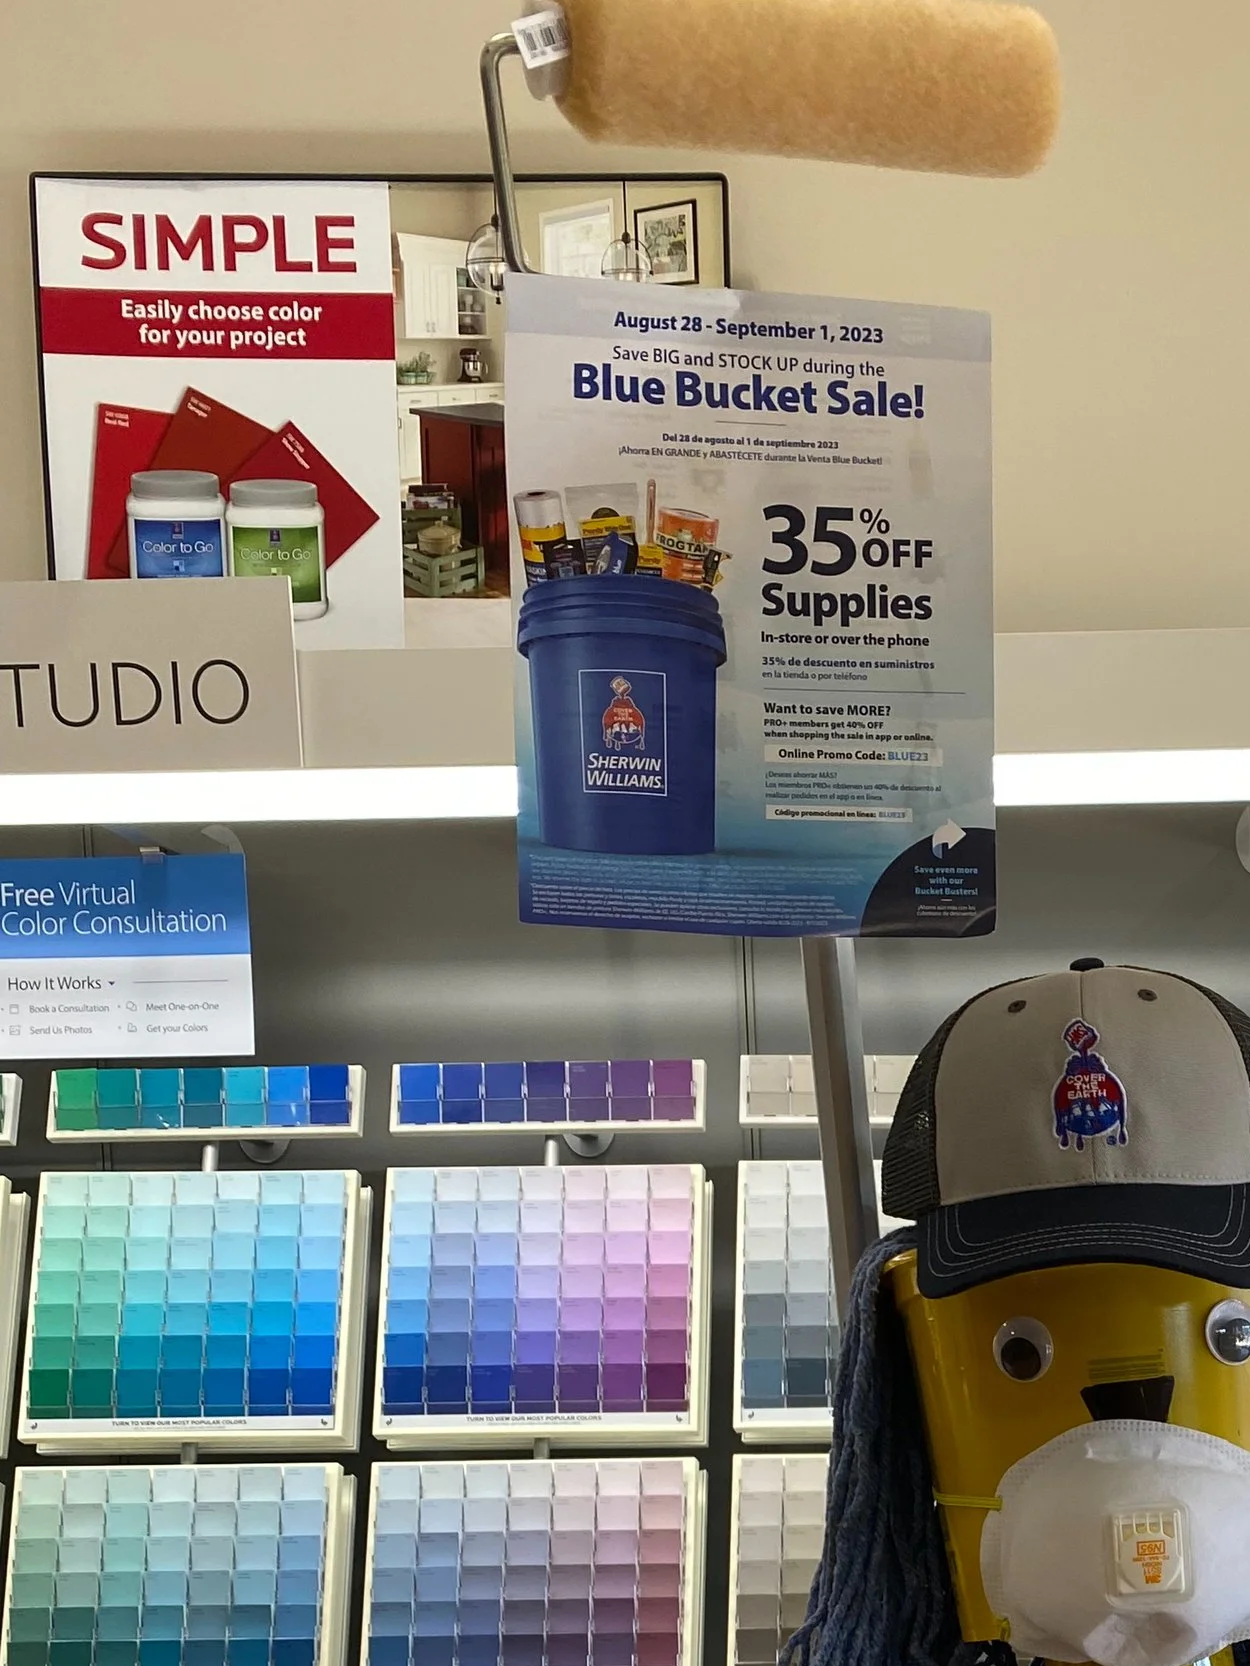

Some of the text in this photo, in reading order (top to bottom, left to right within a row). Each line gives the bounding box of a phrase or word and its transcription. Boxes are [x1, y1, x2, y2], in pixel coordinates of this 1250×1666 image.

[81, 213, 357, 274] SIMPLE
[120, 299, 322, 323] Easily choose color
[139, 323, 307, 351] for your project
[614, 311, 884, 344] August 28 September 1, 2023
[612, 345, 885, 379] Save BIG and STOCK UP during the
[573, 362, 925, 419] Blue Bucket Sale!
[143, 540, 214, 554] Color to Go
[240, 548, 311, 561] Color to Go
[862, 538, 933, 568] OFF
[761, 582, 933, 627] Supplies
[761, 631, 930, 649] In-store or over the phone
[764, 702, 891, 716] Want to save MORE?
[587, 752, 661, 772] SHERWIN
[778, 748, 929, 762] Online Promo Code: BLUE23
[586, 770, 662, 790] WILLIAMS
[1, 879, 136, 907] Free Virtual
[1, 907, 227, 936] Color Consultation
[8, 975, 102, 991] How It Works
[29, 1003, 50, 1013] Book
[58, 1003, 110, 1013] Consultation
[146, 1001, 219, 1012] Meet One-on-One
[1066, 1073, 1106, 1085] COVER
[1074, 1082, 1099, 1090] THE
[1067, 1089, 1107, 1099] EARTH
